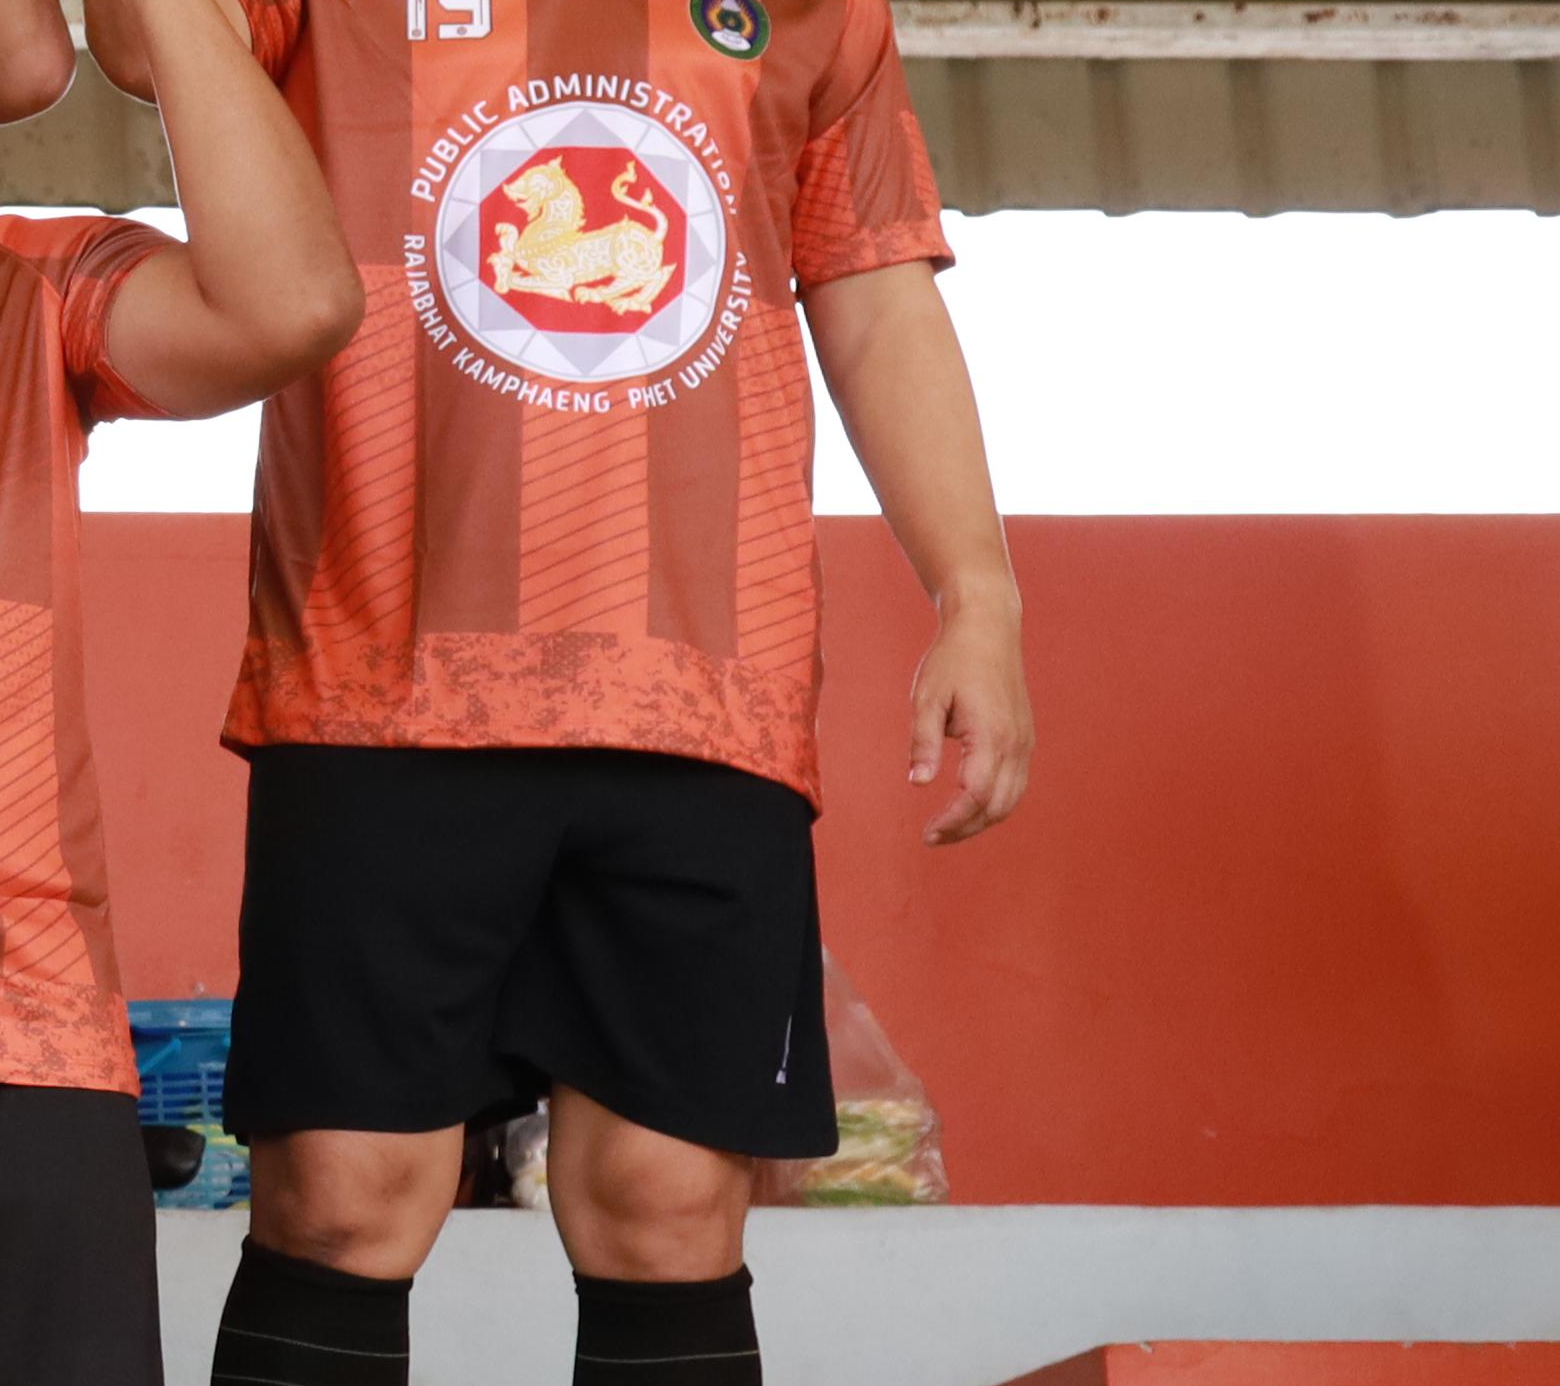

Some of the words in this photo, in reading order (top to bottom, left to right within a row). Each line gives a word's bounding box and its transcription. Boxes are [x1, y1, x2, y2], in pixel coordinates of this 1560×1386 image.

[411, 100, 498, 203] PUBLIC
[452, 346, 610, 413] KAMPHAENG
[628, 377, 677, 409] PHET
[680, 251, 753, 389] UNIVERSITY
